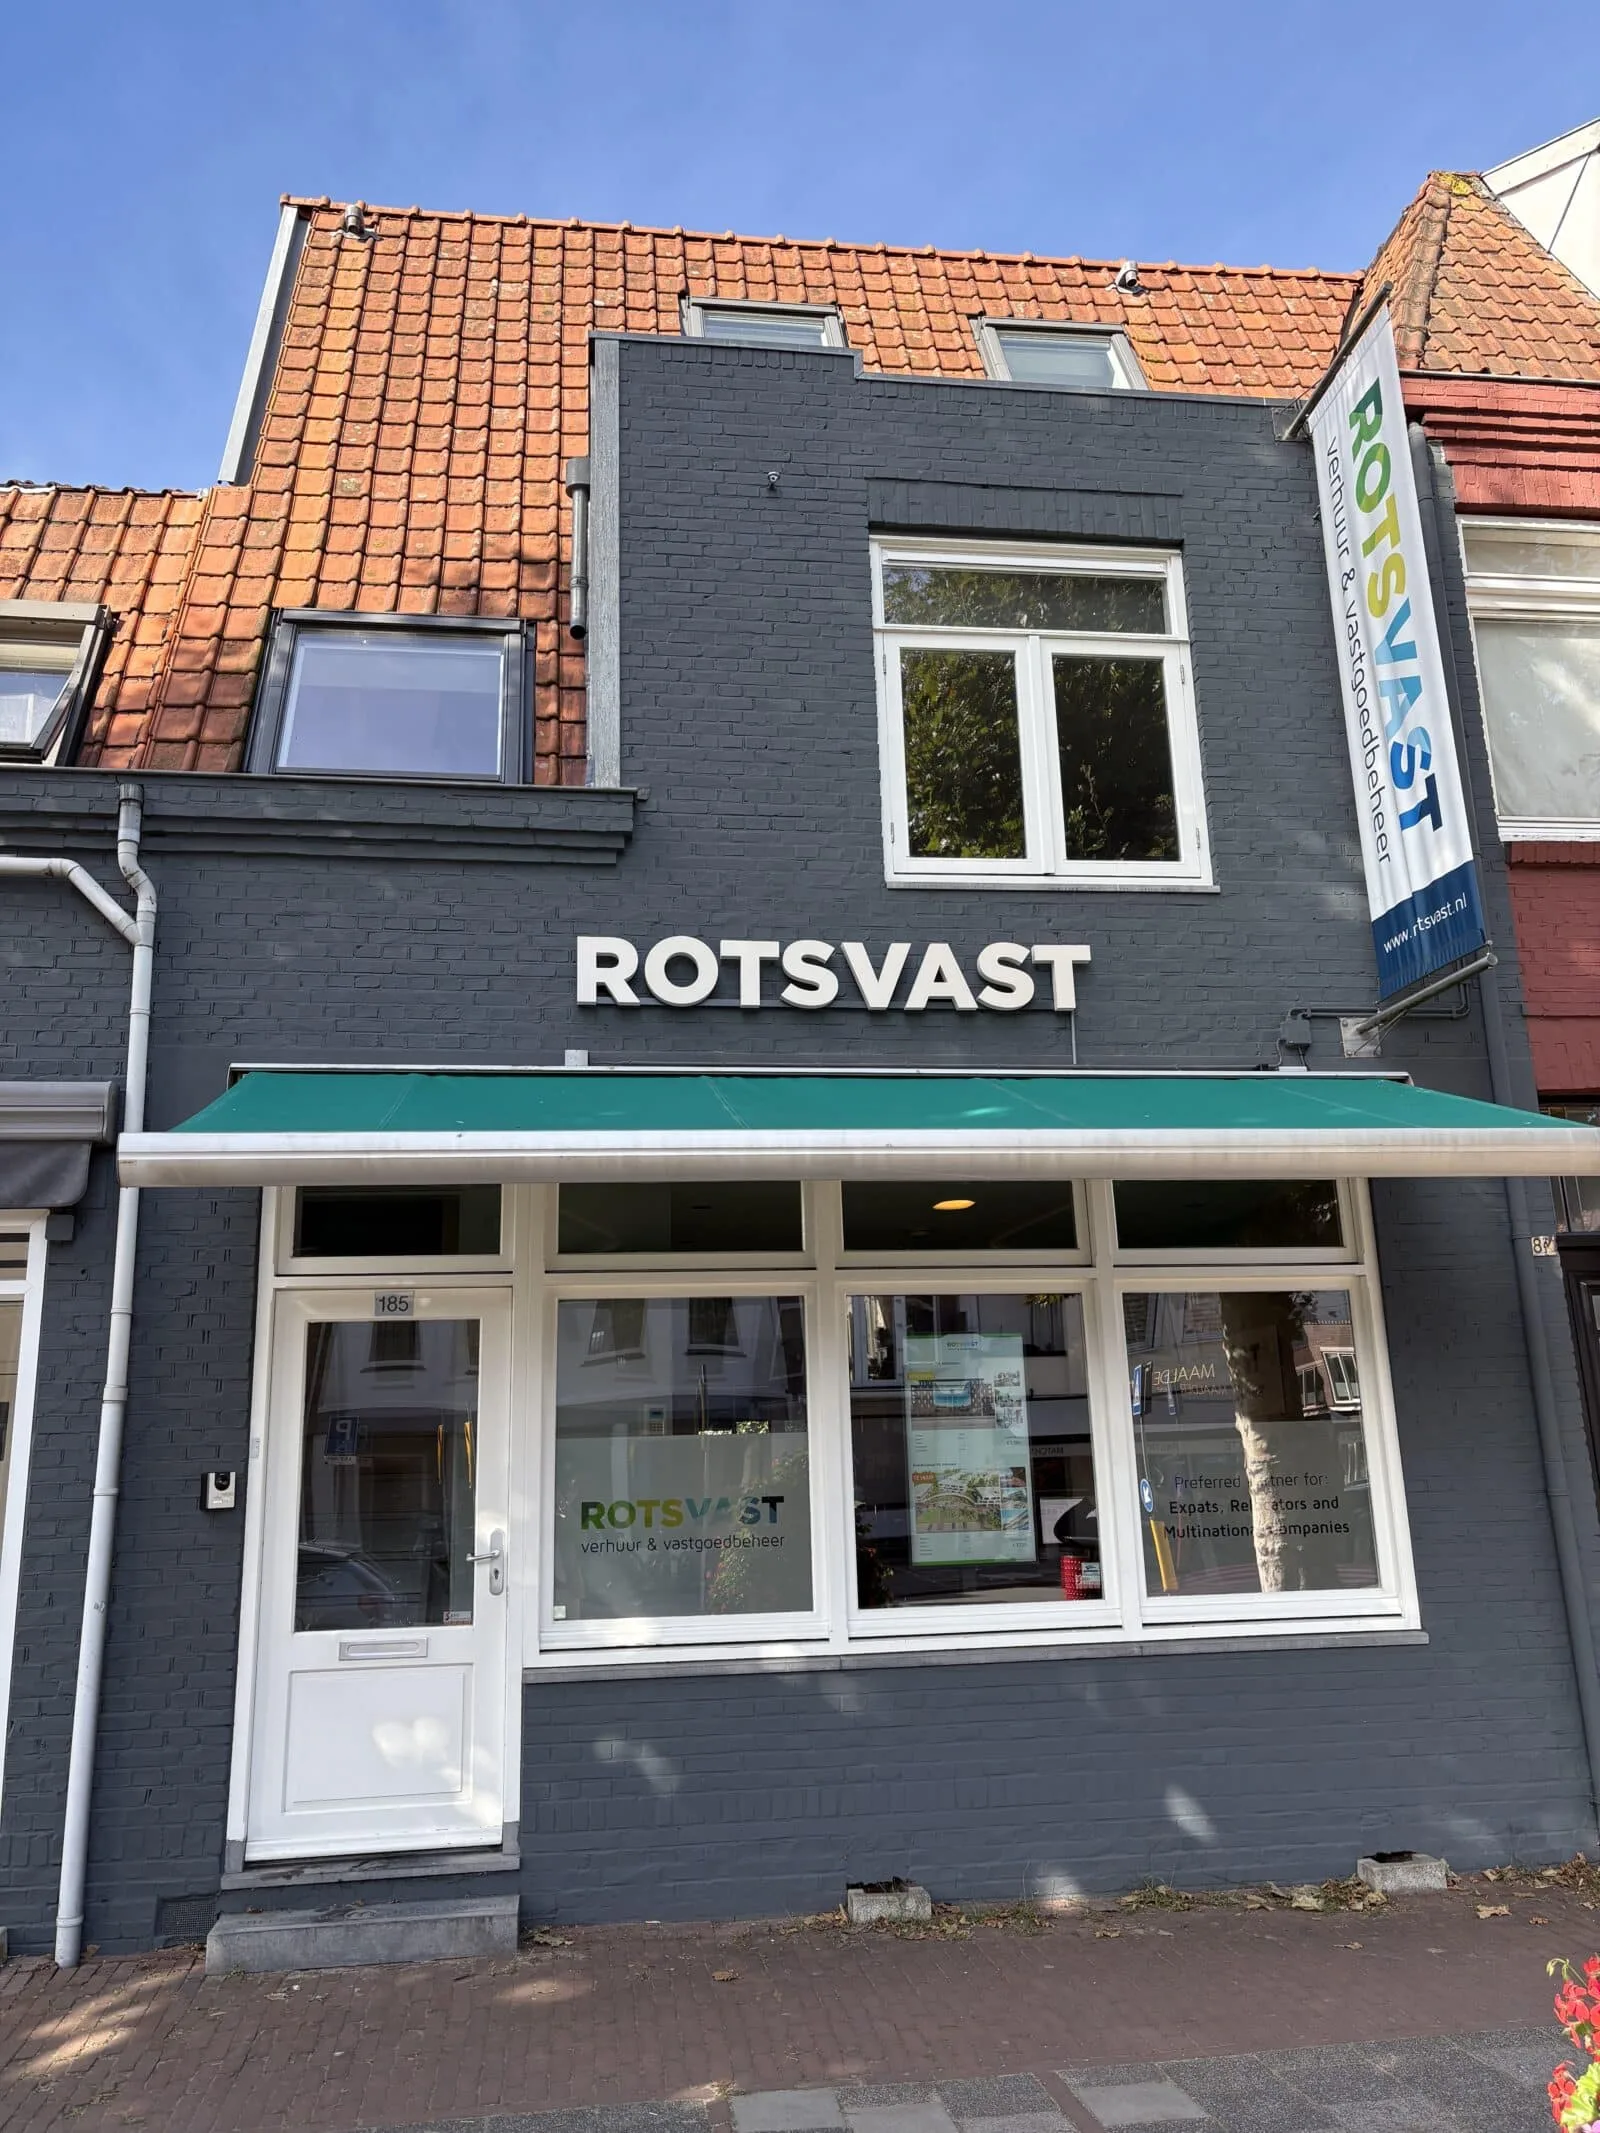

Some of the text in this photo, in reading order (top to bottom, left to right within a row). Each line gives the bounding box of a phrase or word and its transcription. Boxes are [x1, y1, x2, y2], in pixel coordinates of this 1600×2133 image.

[1348, 376, 1443, 832] ROTSVAST
[1327, 435, 1391, 864] verhuur & vastgoedbeheer
[576, 935, 1092, 1012] ROTSVAST
[378, 1295, 409, 1313] 185
[1174, 1475, 1241, 1489] Preferred
[1304, 1472, 1329, 1487] for:
[581, 1496, 785, 1530] ROTSVAST
[1169, 1496, 1339, 1517] Expats, Relators and
[1165, 1521, 1350, 1539] Multination ompanies
[581, 1534, 785, 1553] verhuur & vastgoedbeheer
